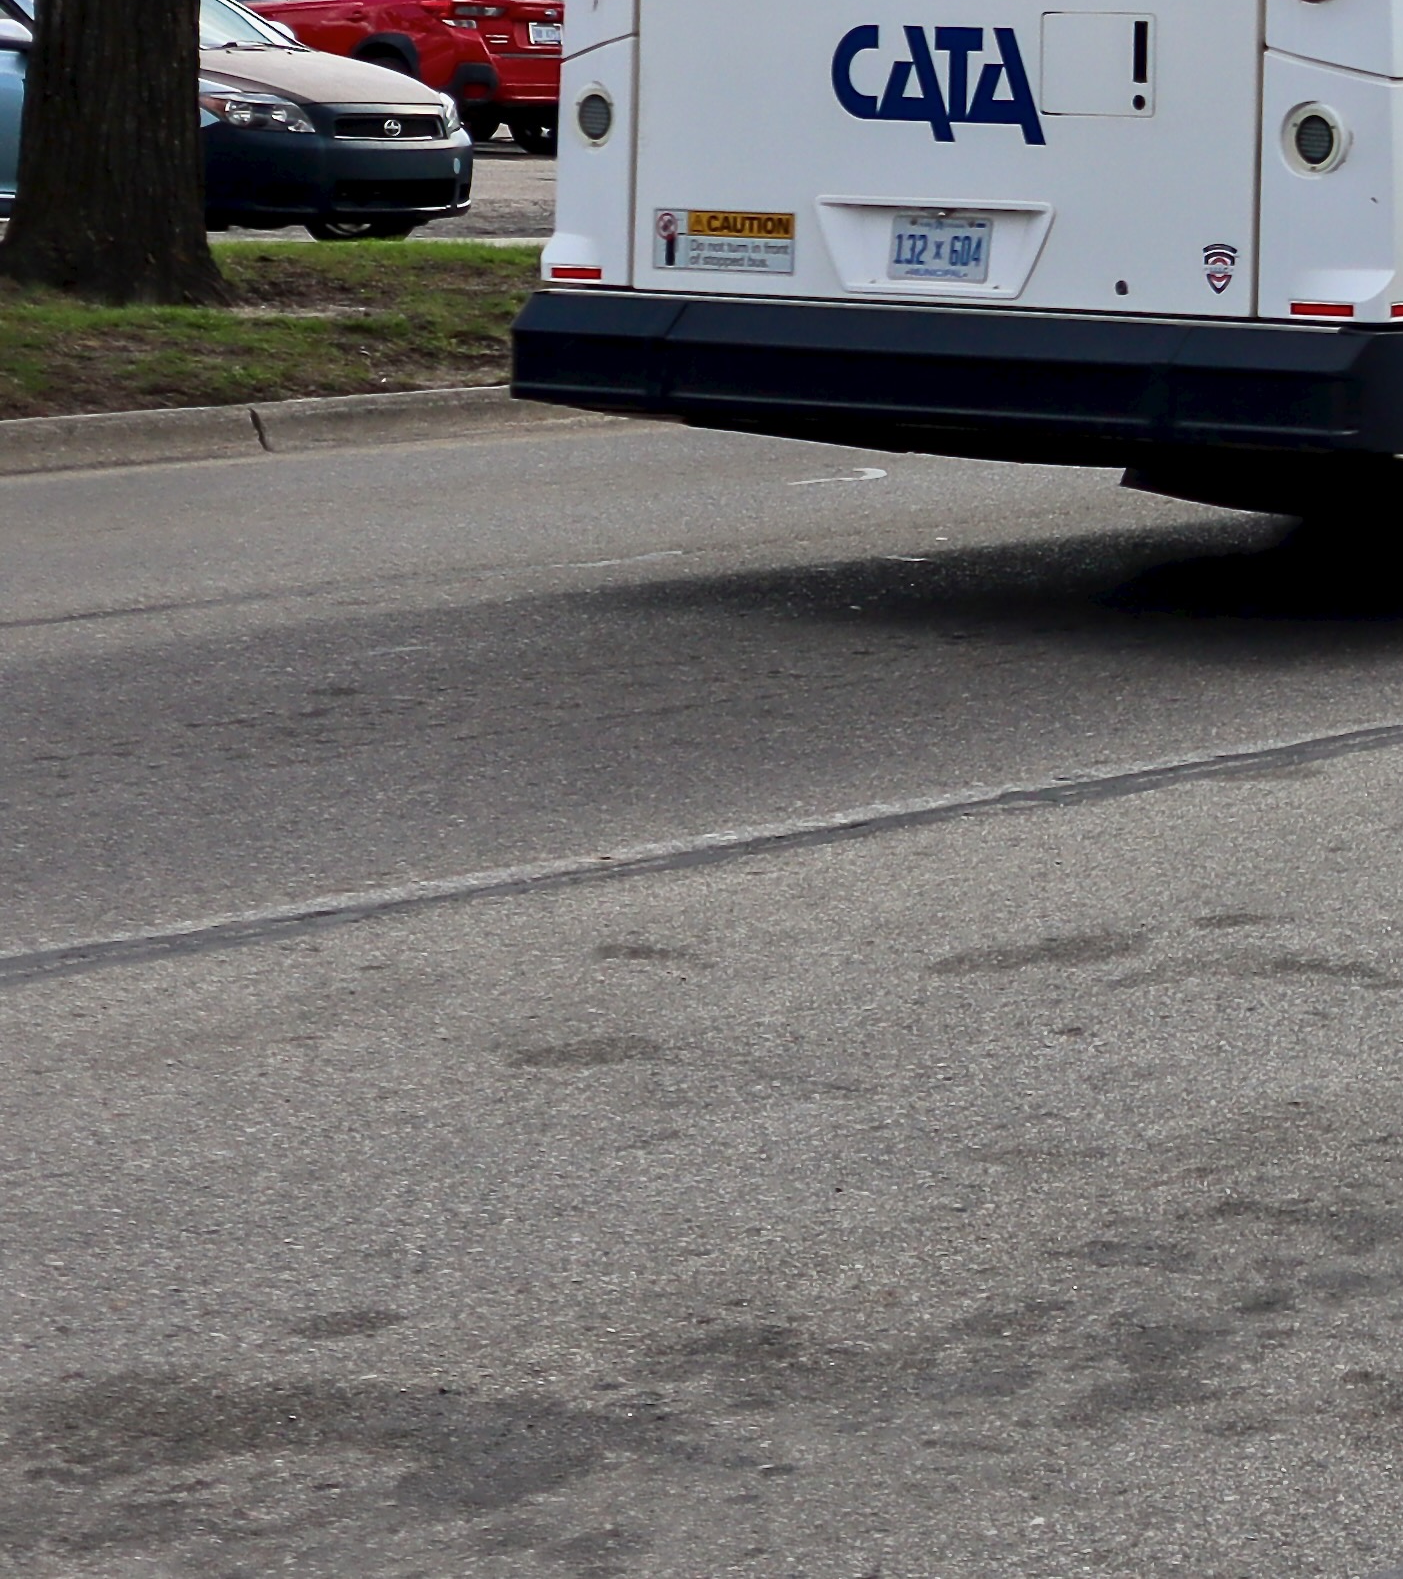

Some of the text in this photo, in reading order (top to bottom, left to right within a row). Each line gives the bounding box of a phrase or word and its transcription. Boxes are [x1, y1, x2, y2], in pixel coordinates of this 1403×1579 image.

[831, 24, 1046, 145] CATA
[706, 215, 791, 235] CAUTION
[690, 239, 705, 252] Do
[707, 240, 724, 252] not
[752, 242, 761, 253] in
[764, 243, 789, 255] front
[894, 234, 928, 265] 132
[949, 235, 983, 267] 604
[703, 256, 745, 269] stopped
